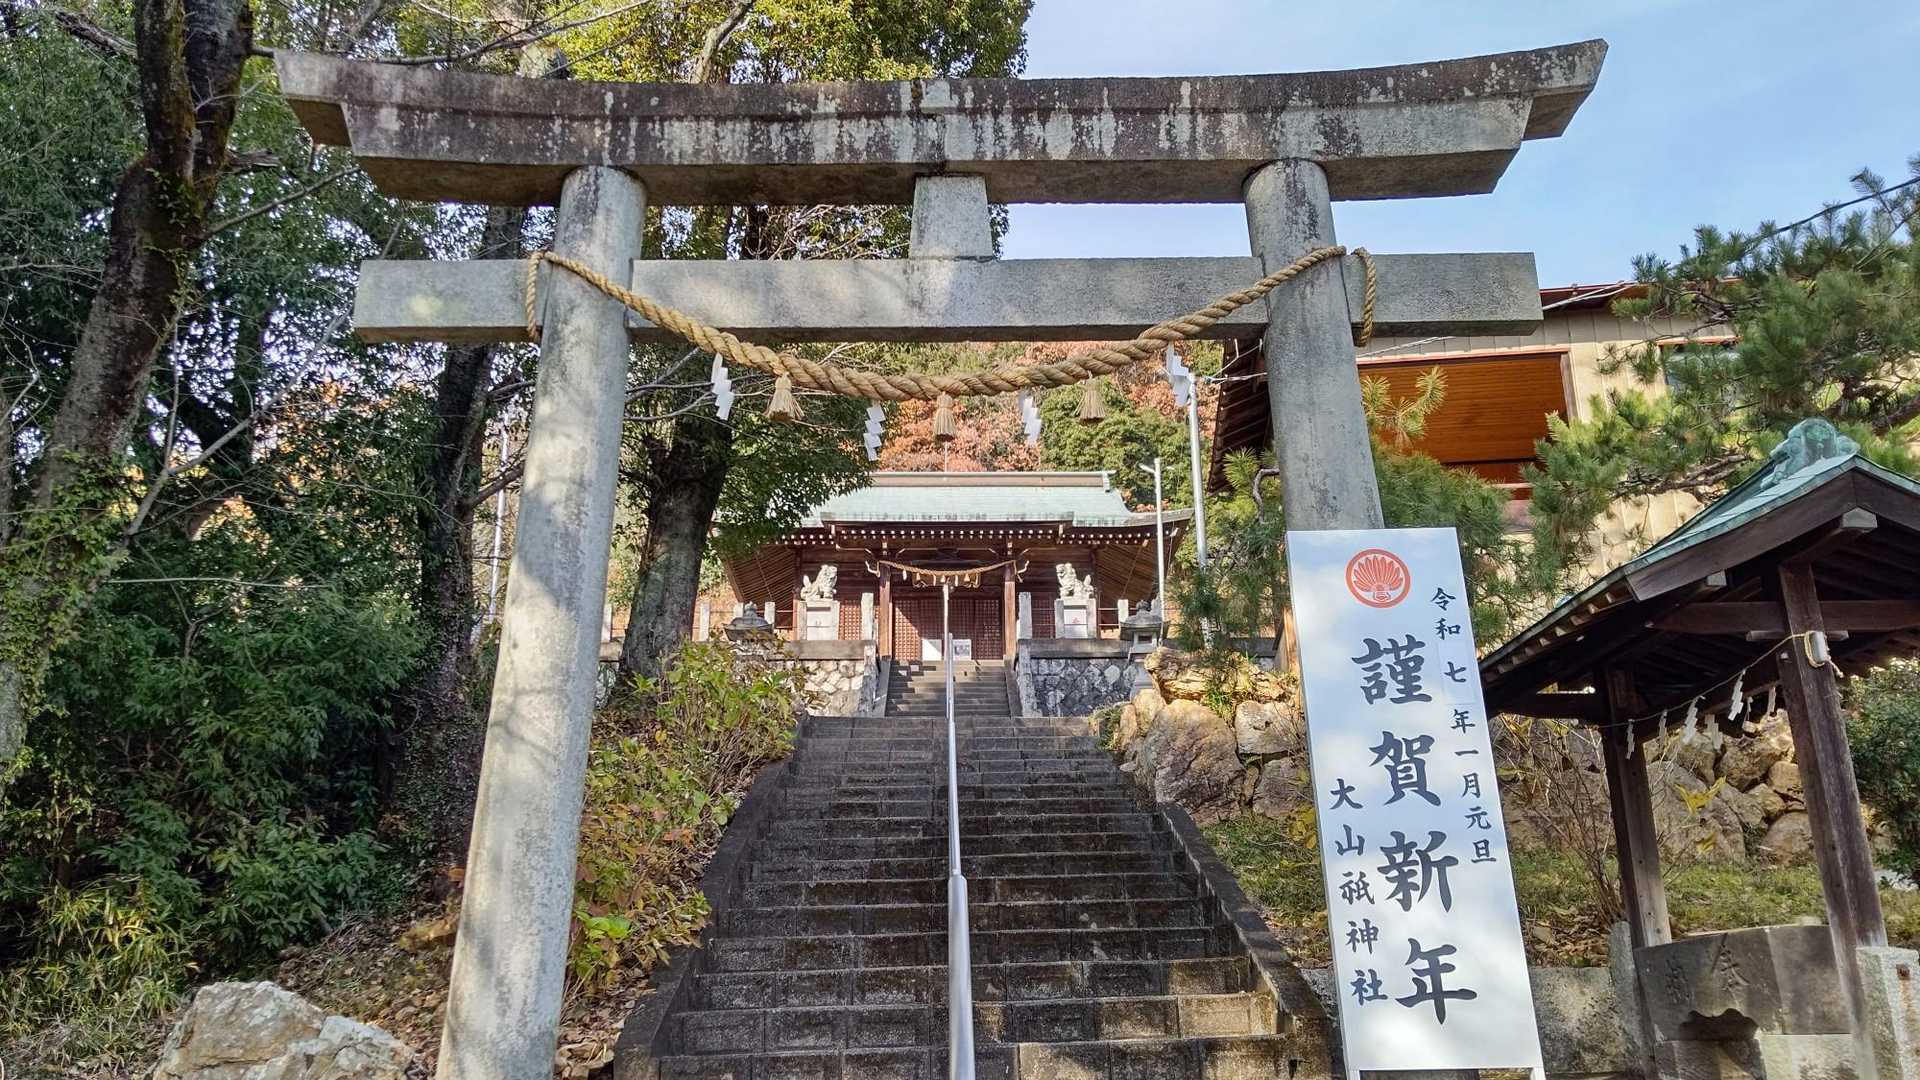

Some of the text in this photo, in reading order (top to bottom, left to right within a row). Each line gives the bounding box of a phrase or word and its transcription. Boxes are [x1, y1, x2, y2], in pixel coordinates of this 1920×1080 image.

[1351, 633, 1478, 1025] 謹賀新年
[1430, 587, 1497, 864] 令和七年一月元旦
